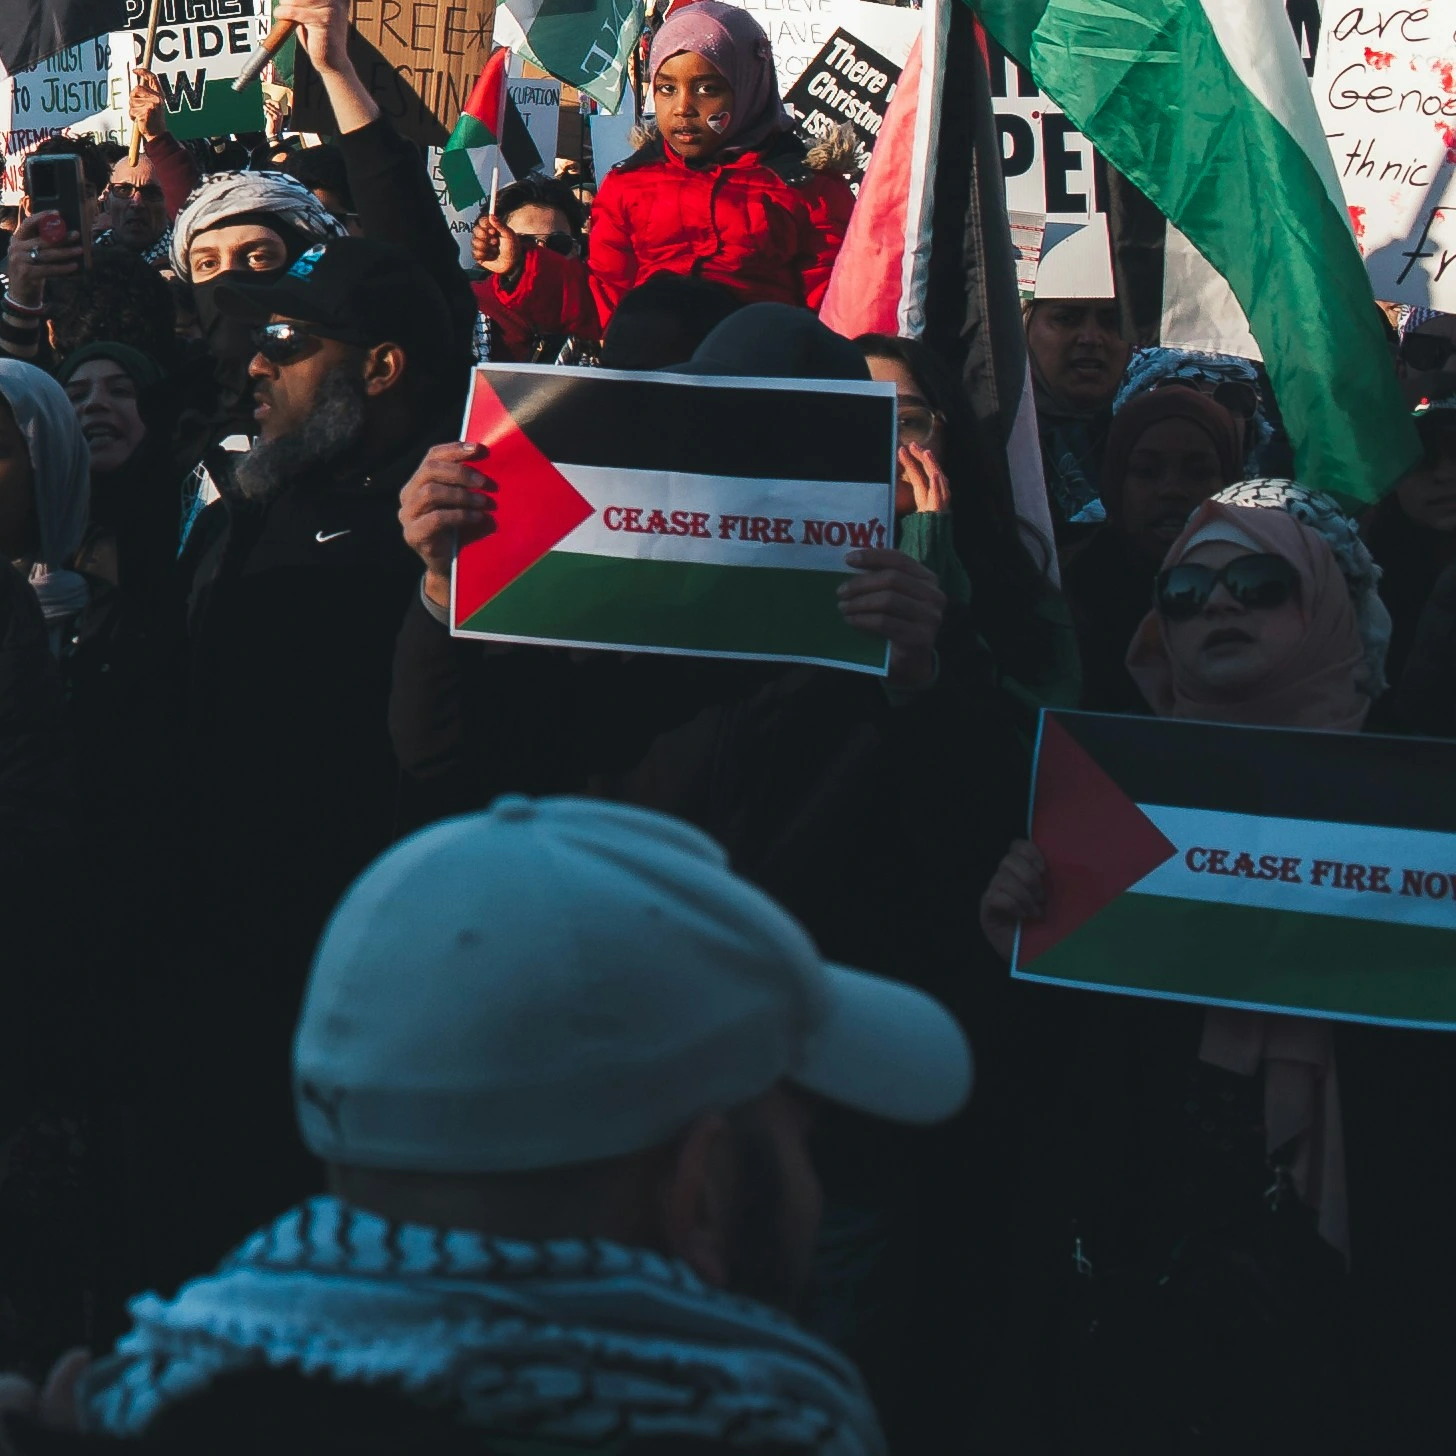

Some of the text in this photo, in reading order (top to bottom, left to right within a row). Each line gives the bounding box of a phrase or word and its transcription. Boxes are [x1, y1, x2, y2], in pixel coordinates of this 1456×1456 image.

[1333, 7, 1431, 42] are
[824, 36, 888, 95] There
[11, 76, 31, 115] to
[1326, 131, 1430, 188] thnic
[602, 505, 888, 550] CEASE FIRE NOW!
[1184, 846, 1303, 885] CEASE
[1309, 858, 1393, 894] FIRE
